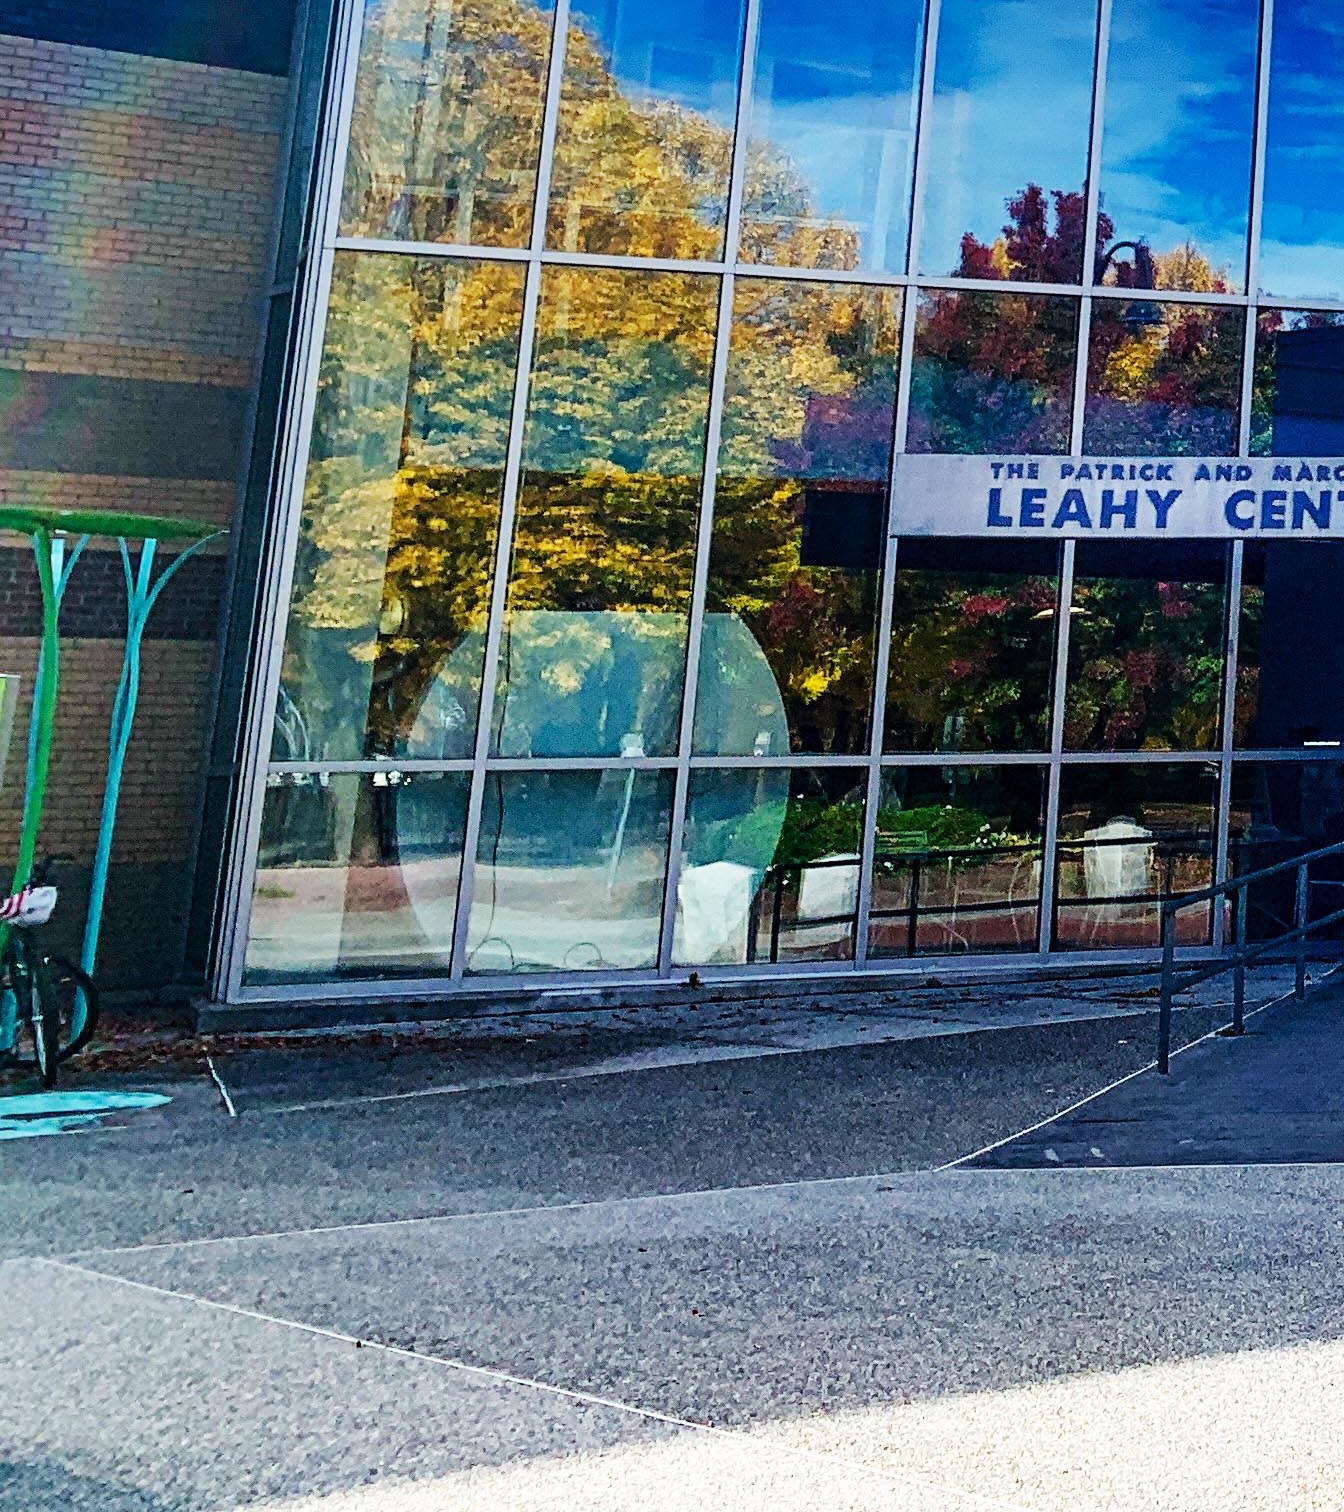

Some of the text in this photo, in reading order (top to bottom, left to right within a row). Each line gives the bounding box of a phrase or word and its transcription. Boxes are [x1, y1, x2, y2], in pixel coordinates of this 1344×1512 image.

[990, 462, 1039, 480] THE
[1060, 462, 1174, 481] PATRICK
[1193, 463, 1253, 482] AND
[986, 487, 1183, 529] LEAHY
